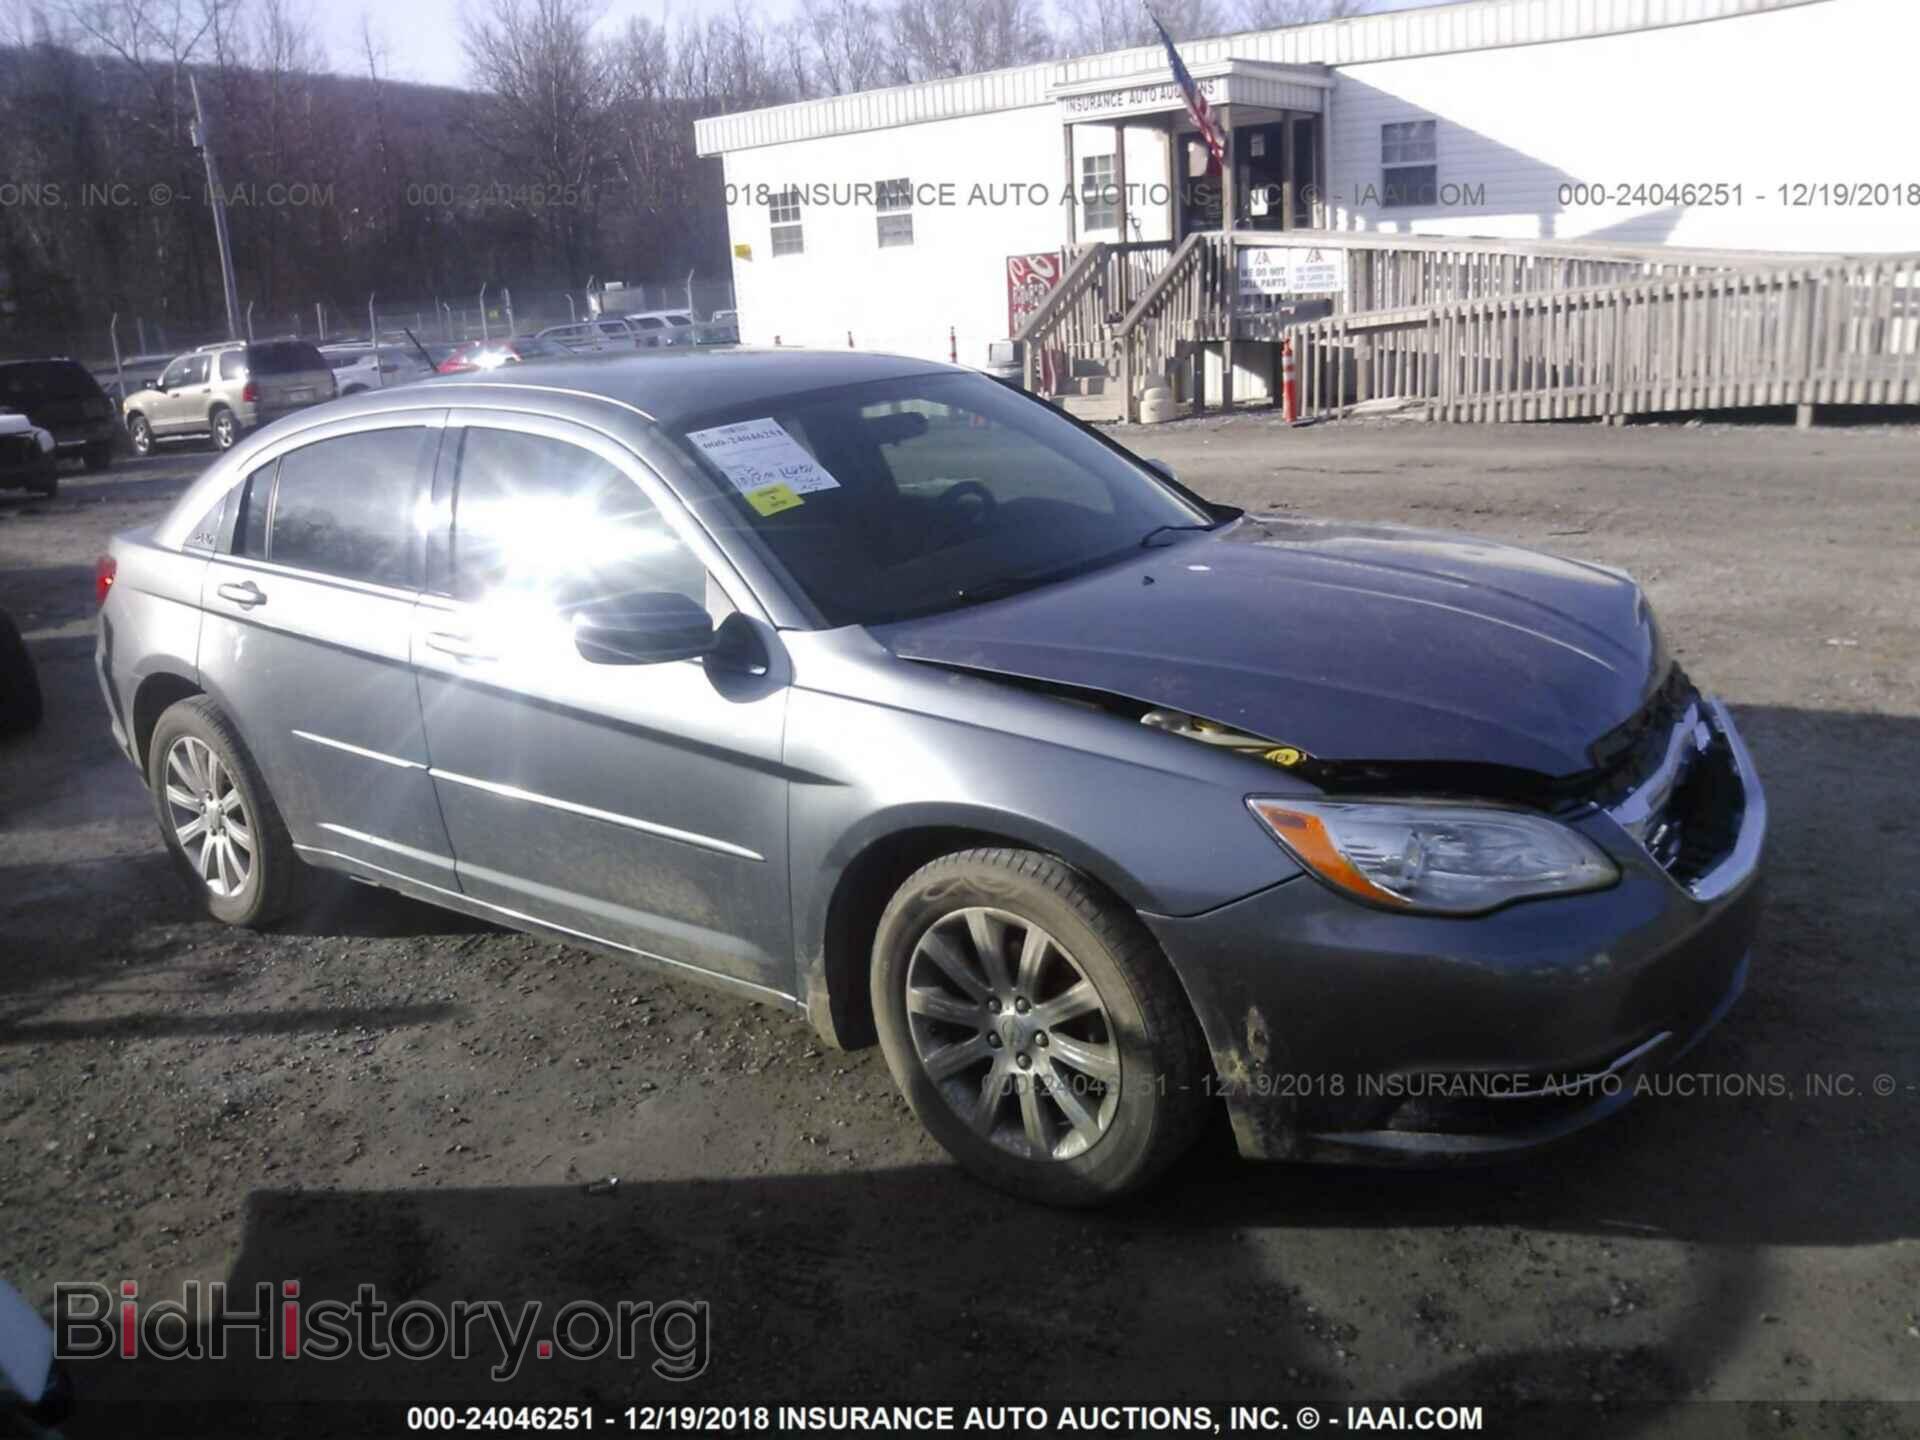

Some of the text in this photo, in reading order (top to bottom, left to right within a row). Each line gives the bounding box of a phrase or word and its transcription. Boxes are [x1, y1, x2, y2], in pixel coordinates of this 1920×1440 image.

[1065, 79, 1215, 113] INSURANCE AUTO AUCNS
